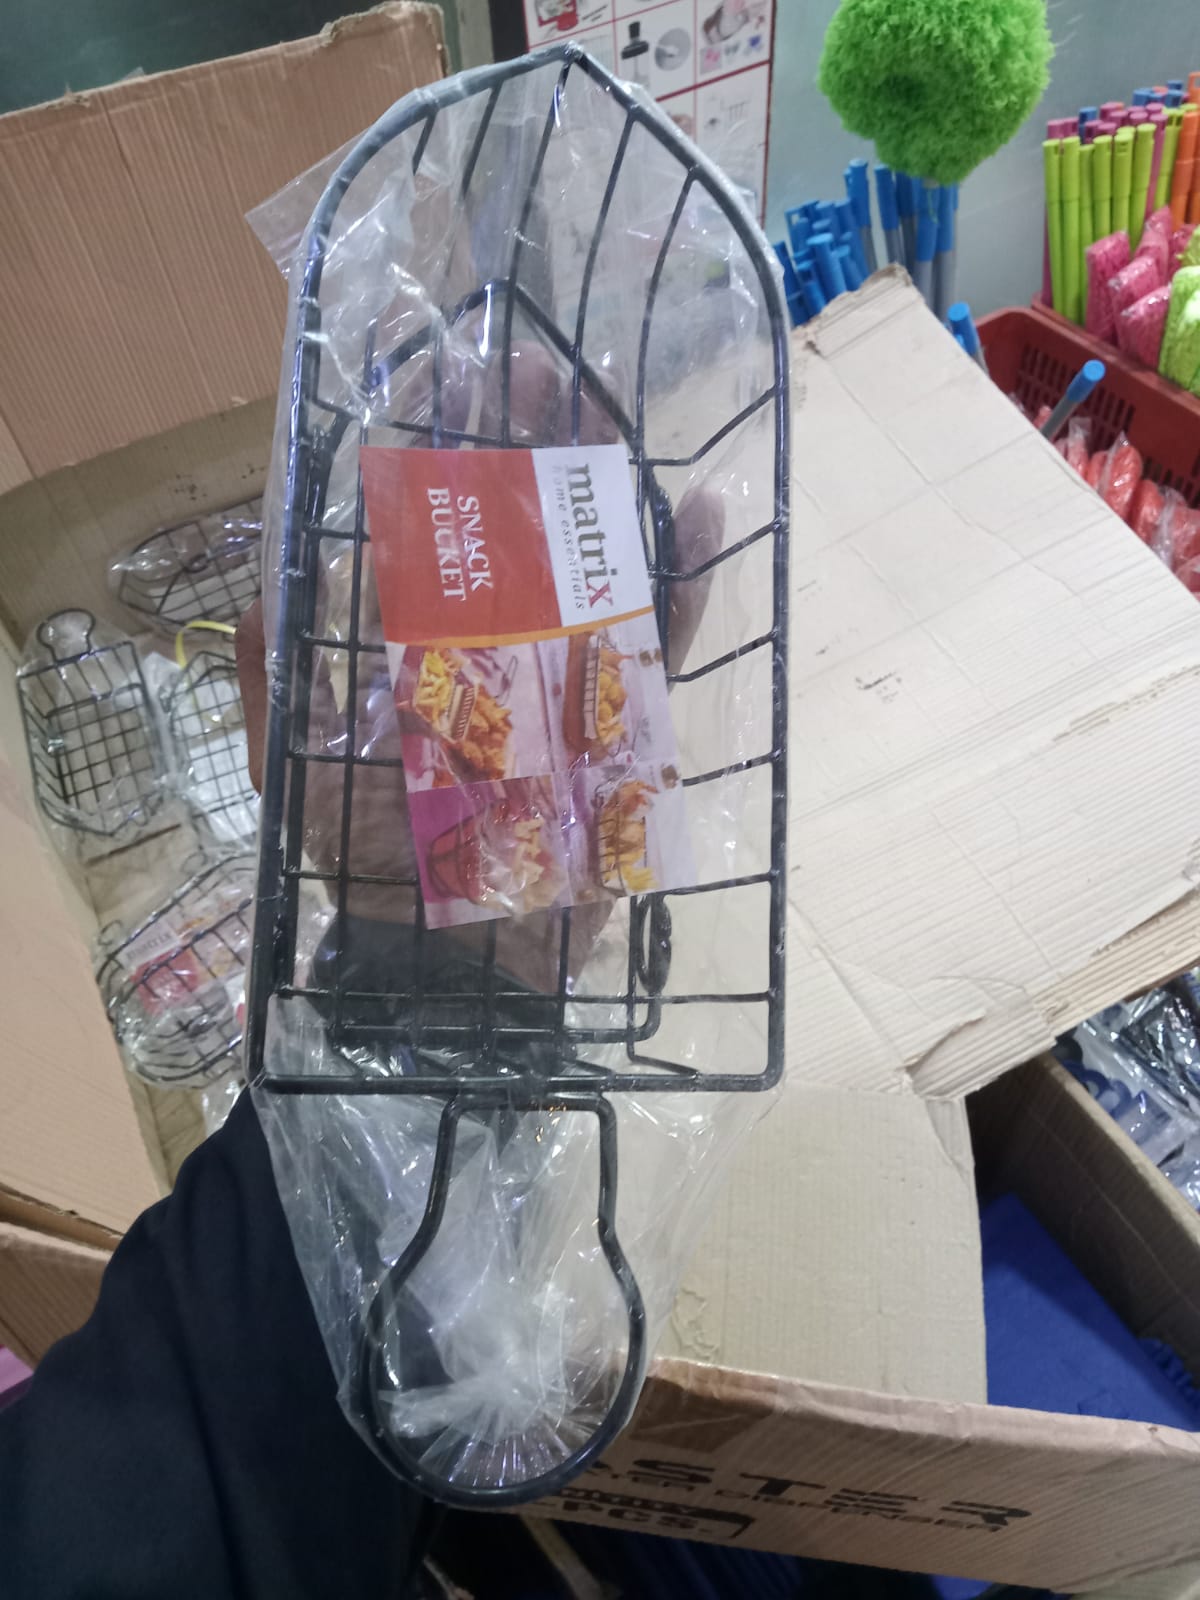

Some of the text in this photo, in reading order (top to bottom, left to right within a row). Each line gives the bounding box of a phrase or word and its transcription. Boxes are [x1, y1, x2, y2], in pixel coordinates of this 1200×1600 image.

[427, 488, 466, 601] BUCKET
[457, 495, 493, 592] SNACK
[552, 465, 586, 609] home essentials
[565, 463, 618, 608] matrix
